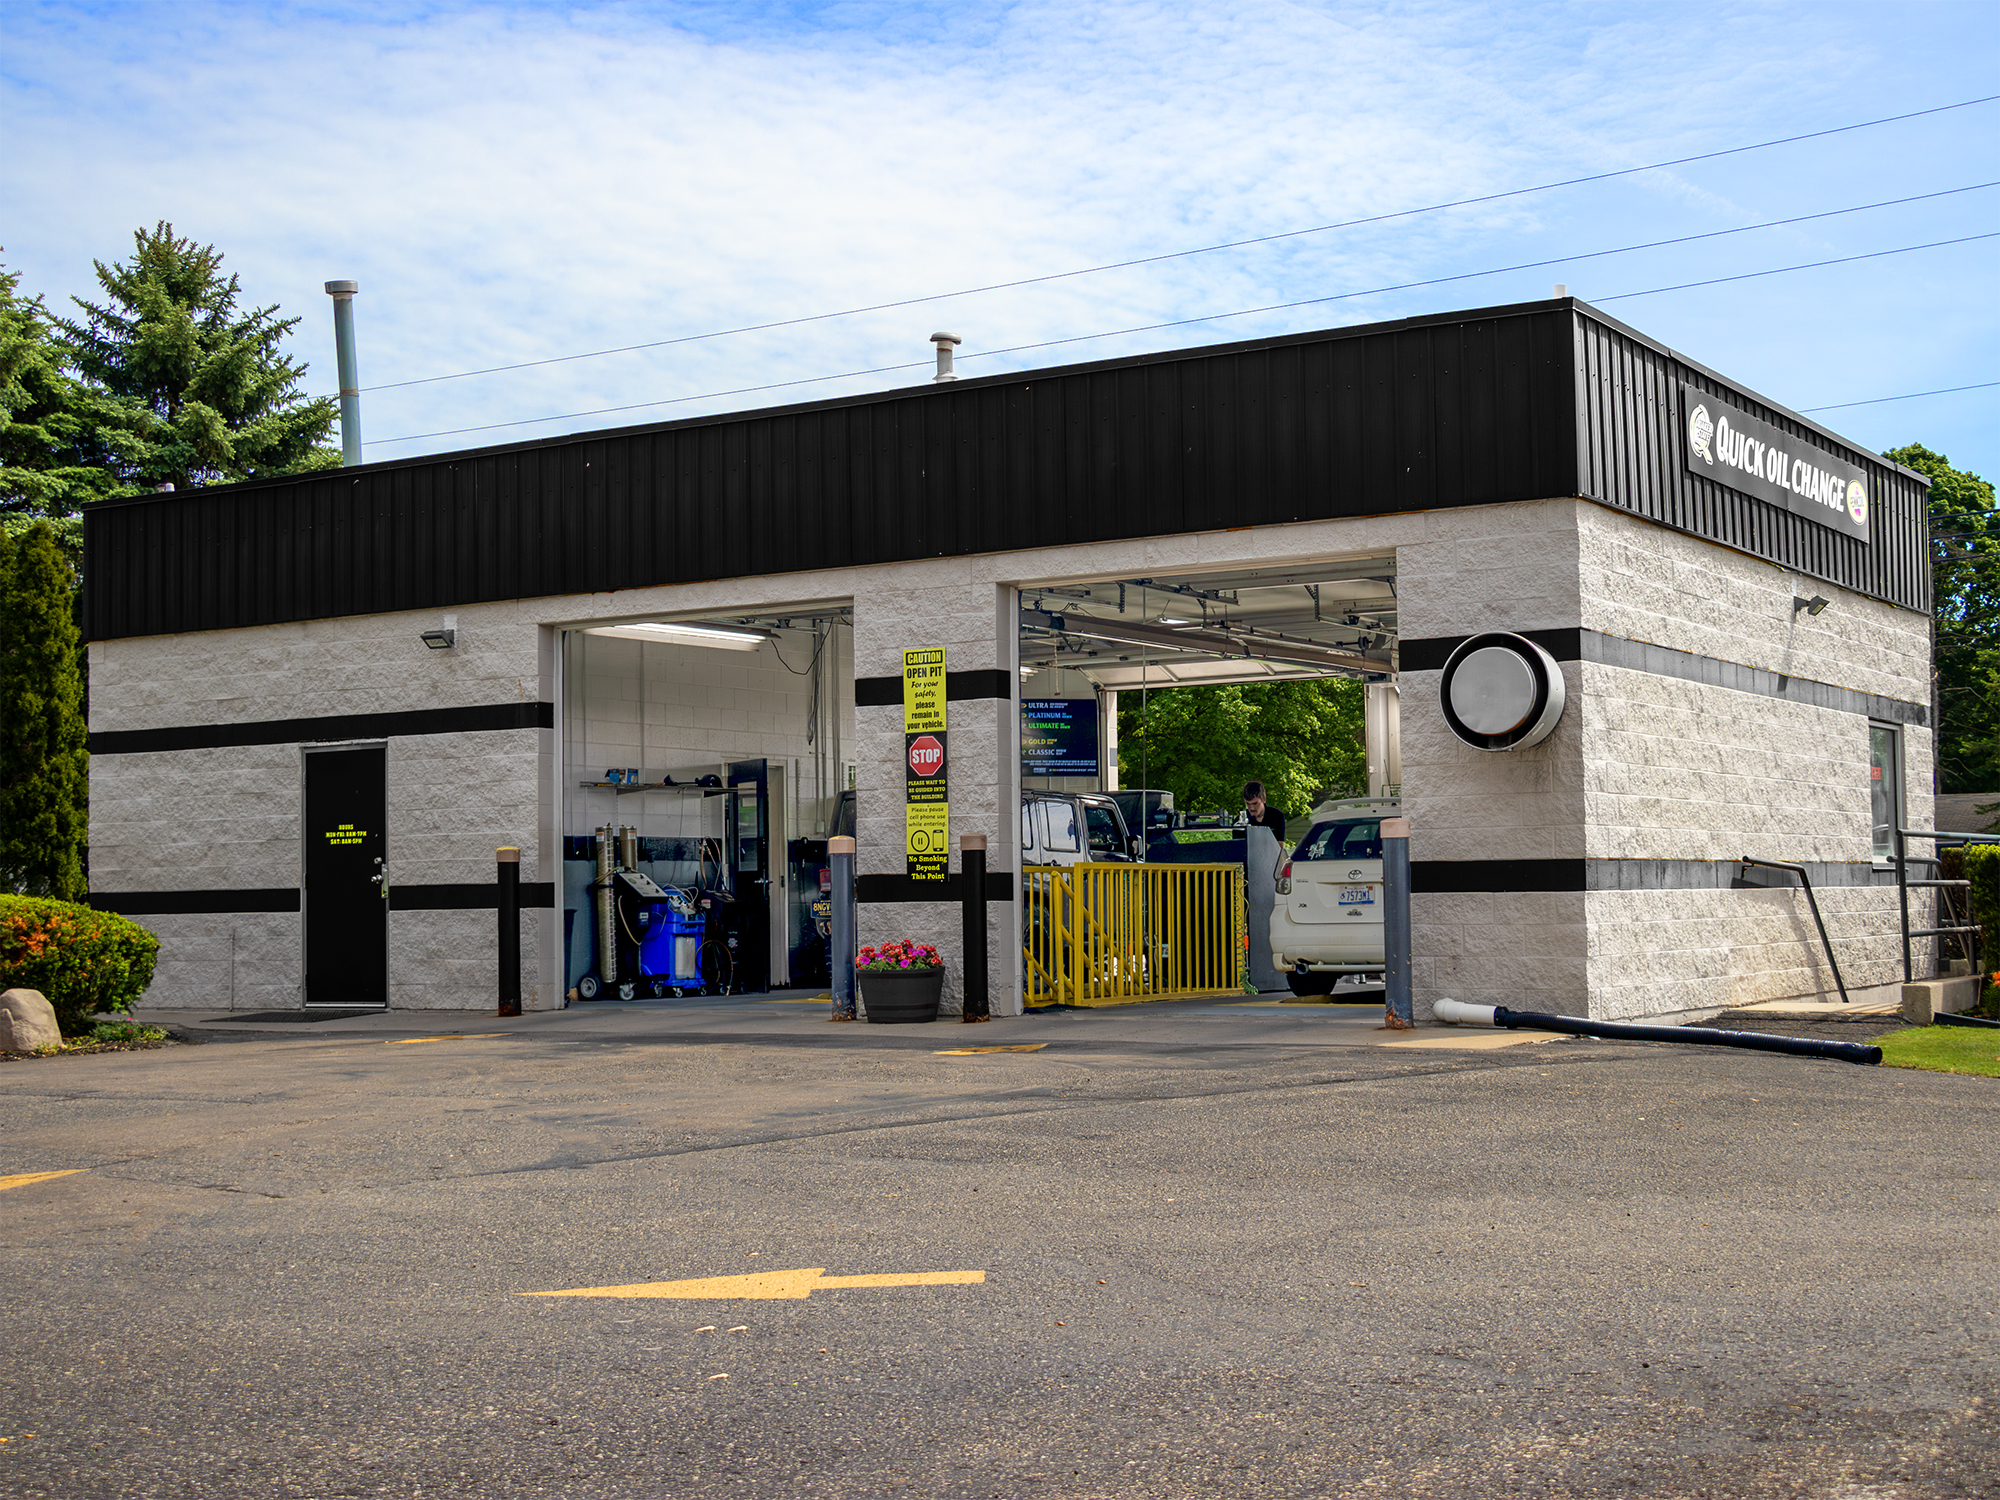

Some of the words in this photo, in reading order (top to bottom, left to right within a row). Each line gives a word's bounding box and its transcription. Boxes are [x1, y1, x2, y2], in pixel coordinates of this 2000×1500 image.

[1716, 416, 1765, 479] QUICK
[1766, 447, 1790, 490] OIL
[1791, 459, 1846, 512] CHANGE
[907, 652, 941, 664] CAUTION
[907, 667, 927, 679] OPEN
[930, 666, 942, 677] PIT
[915, 701, 935, 709] please
[911, 710, 932, 719] remain
[907, 722, 920, 730] your
[912, 748, 940, 764] STOP
[908, 855, 918, 863] No
[918, 854, 948, 863] Smoking
[915, 864, 940, 872] Beyond
[927, 872, 945, 880] Point
